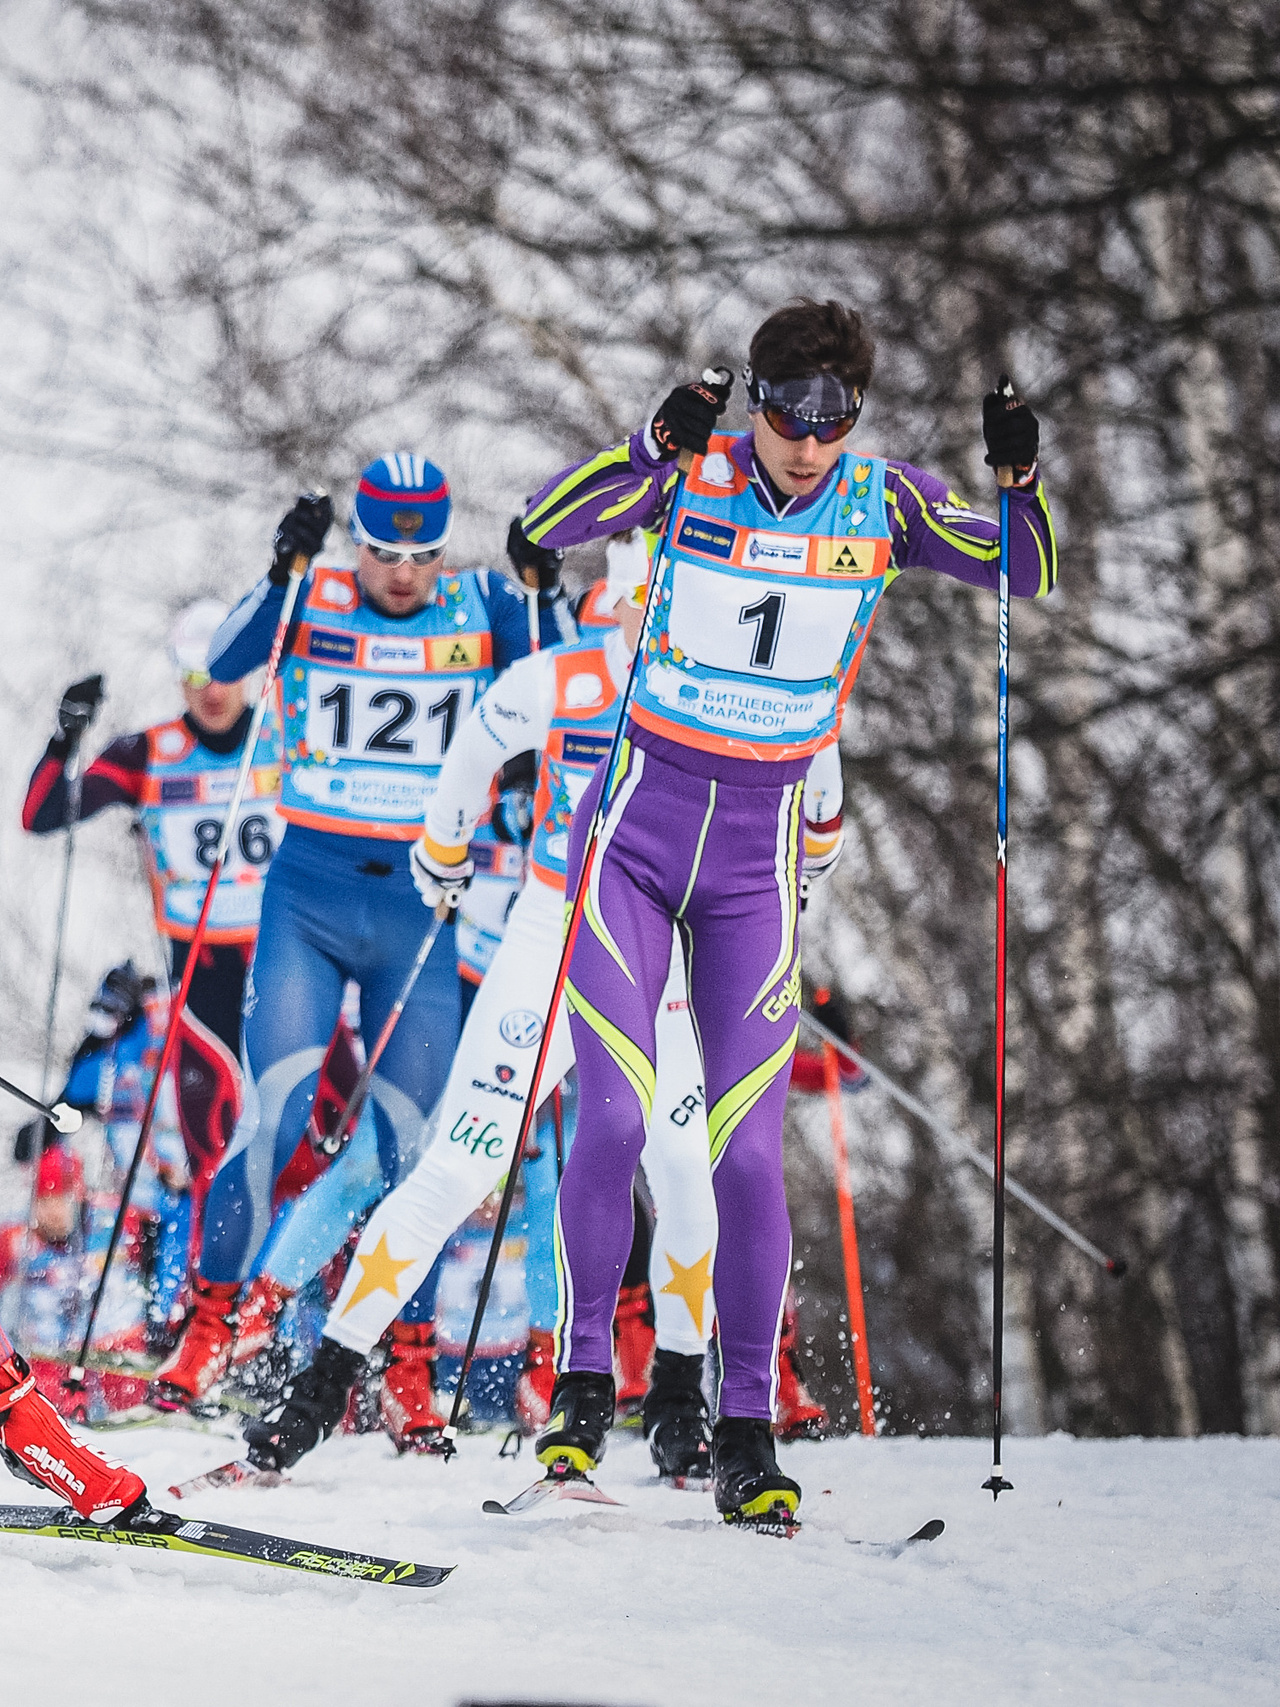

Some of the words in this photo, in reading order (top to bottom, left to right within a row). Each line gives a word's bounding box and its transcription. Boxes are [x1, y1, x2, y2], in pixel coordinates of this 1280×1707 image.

[738, 591, 787, 670] 1
[999, 570, 1009, 676] SWIX
[320, 683, 462, 755] 121
[701, 703, 787, 729] МАРАФОН
[704, 689, 814, 715] БИТЦЕВСКИЙ
[194, 814, 272, 869] 86
[449, 1110, 504, 1159] life
[23, 1443, 86, 1496] alpina
[57, 1528, 171, 1550] FISCHER
[286, 1550, 387, 1579] FISCHER
